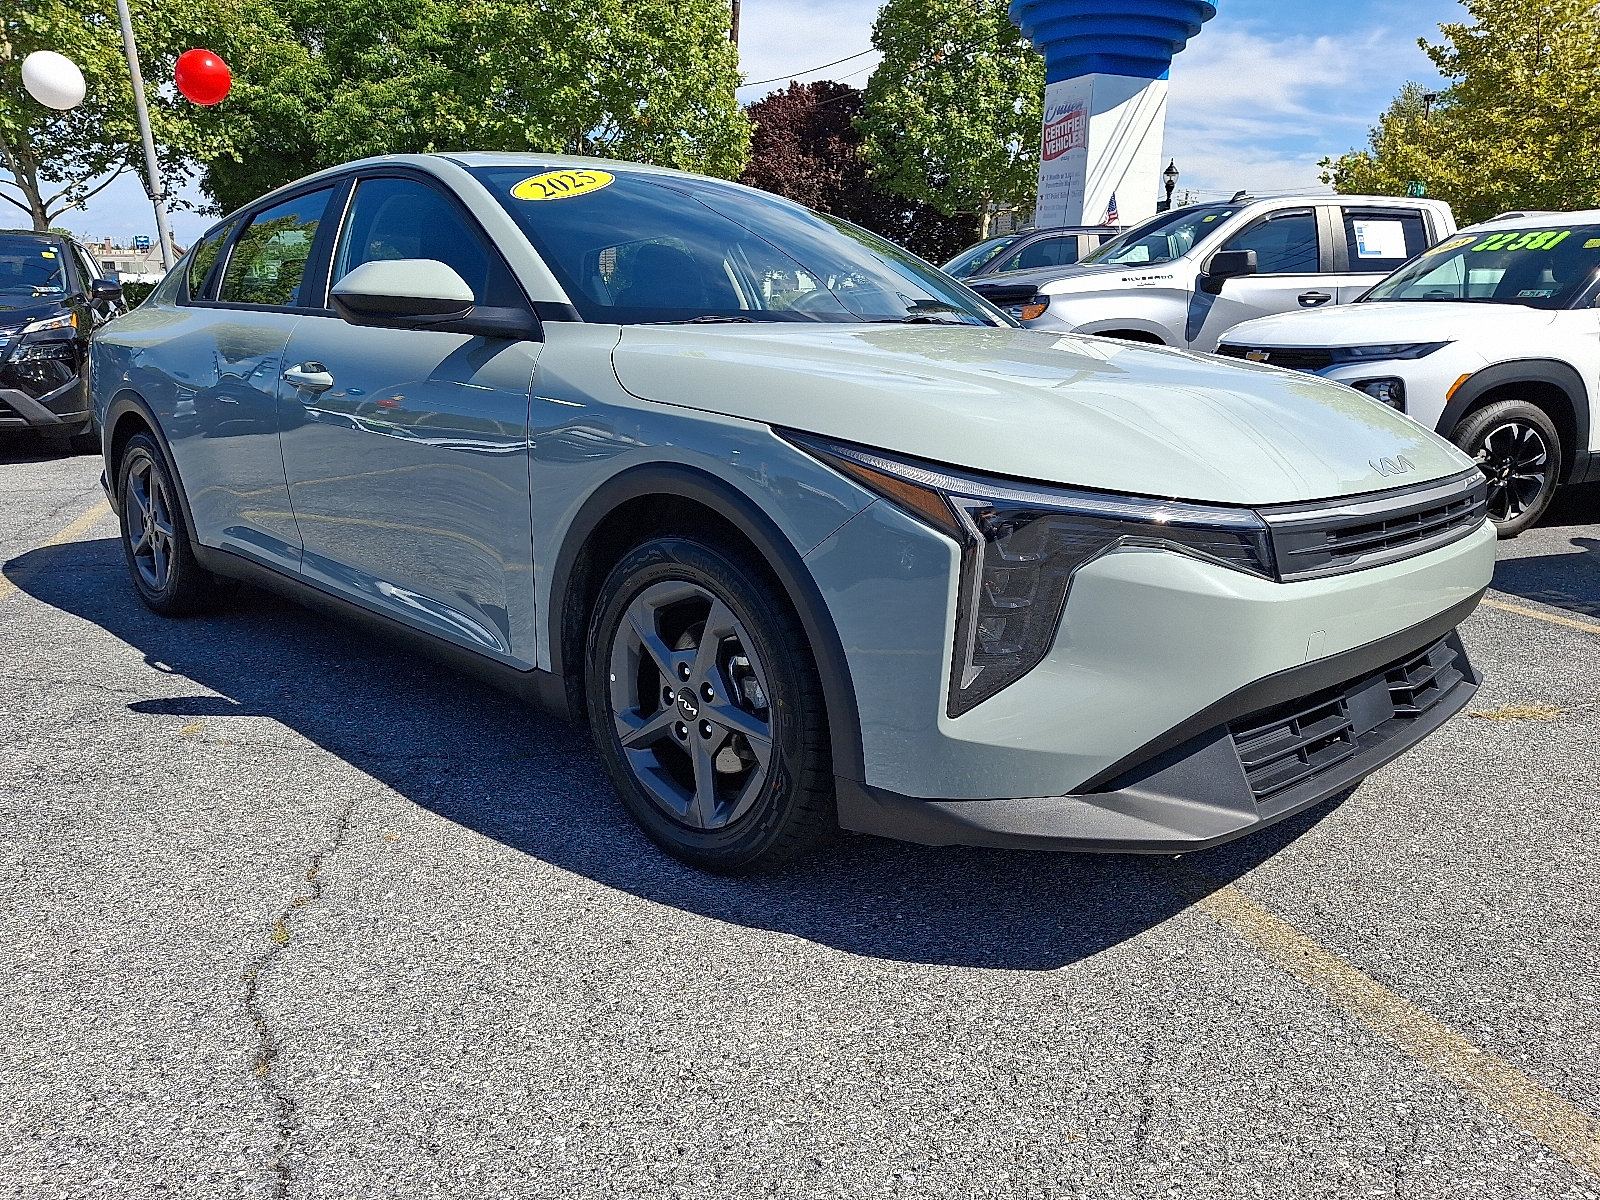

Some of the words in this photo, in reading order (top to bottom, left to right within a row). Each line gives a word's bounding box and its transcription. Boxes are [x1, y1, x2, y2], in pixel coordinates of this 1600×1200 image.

[1045, 114, 1086, 142] CERTIFIED
[1045, 130, 1085, 156] VEHICLES
[530, 171, 597, 197] 2025
[1470, 230, 1572, 252] 22581
